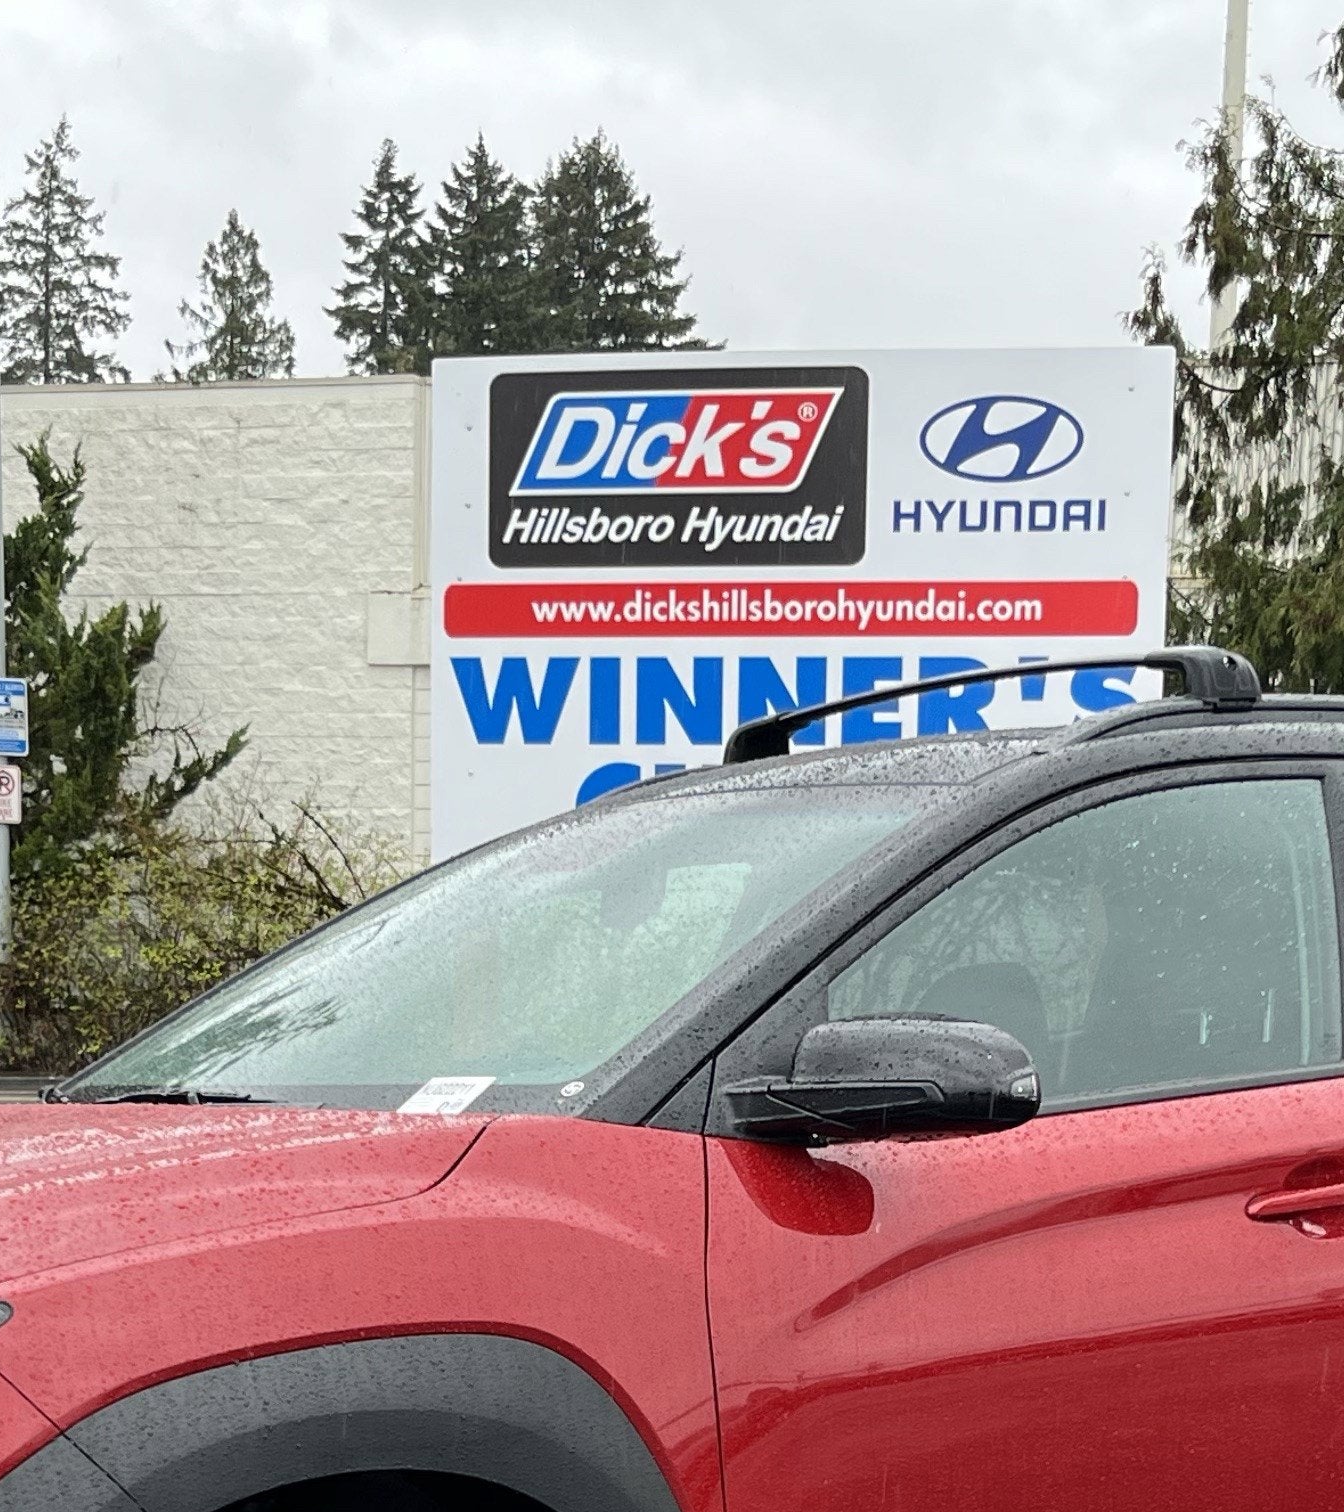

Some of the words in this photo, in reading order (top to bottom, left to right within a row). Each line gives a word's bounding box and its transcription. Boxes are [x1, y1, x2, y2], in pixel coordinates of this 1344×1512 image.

[536, 400, 802, 480] Dick's
[502, 505, 674, 545] Hillsboro
[681, 505, 844, 551] Hyundai
[893, 500, 1106, 532] HYUNDAI
[532, 588, 1043, 631] www.dickshillsborohyundai.com
[451, 656, 1137, 746] WINNER'S
